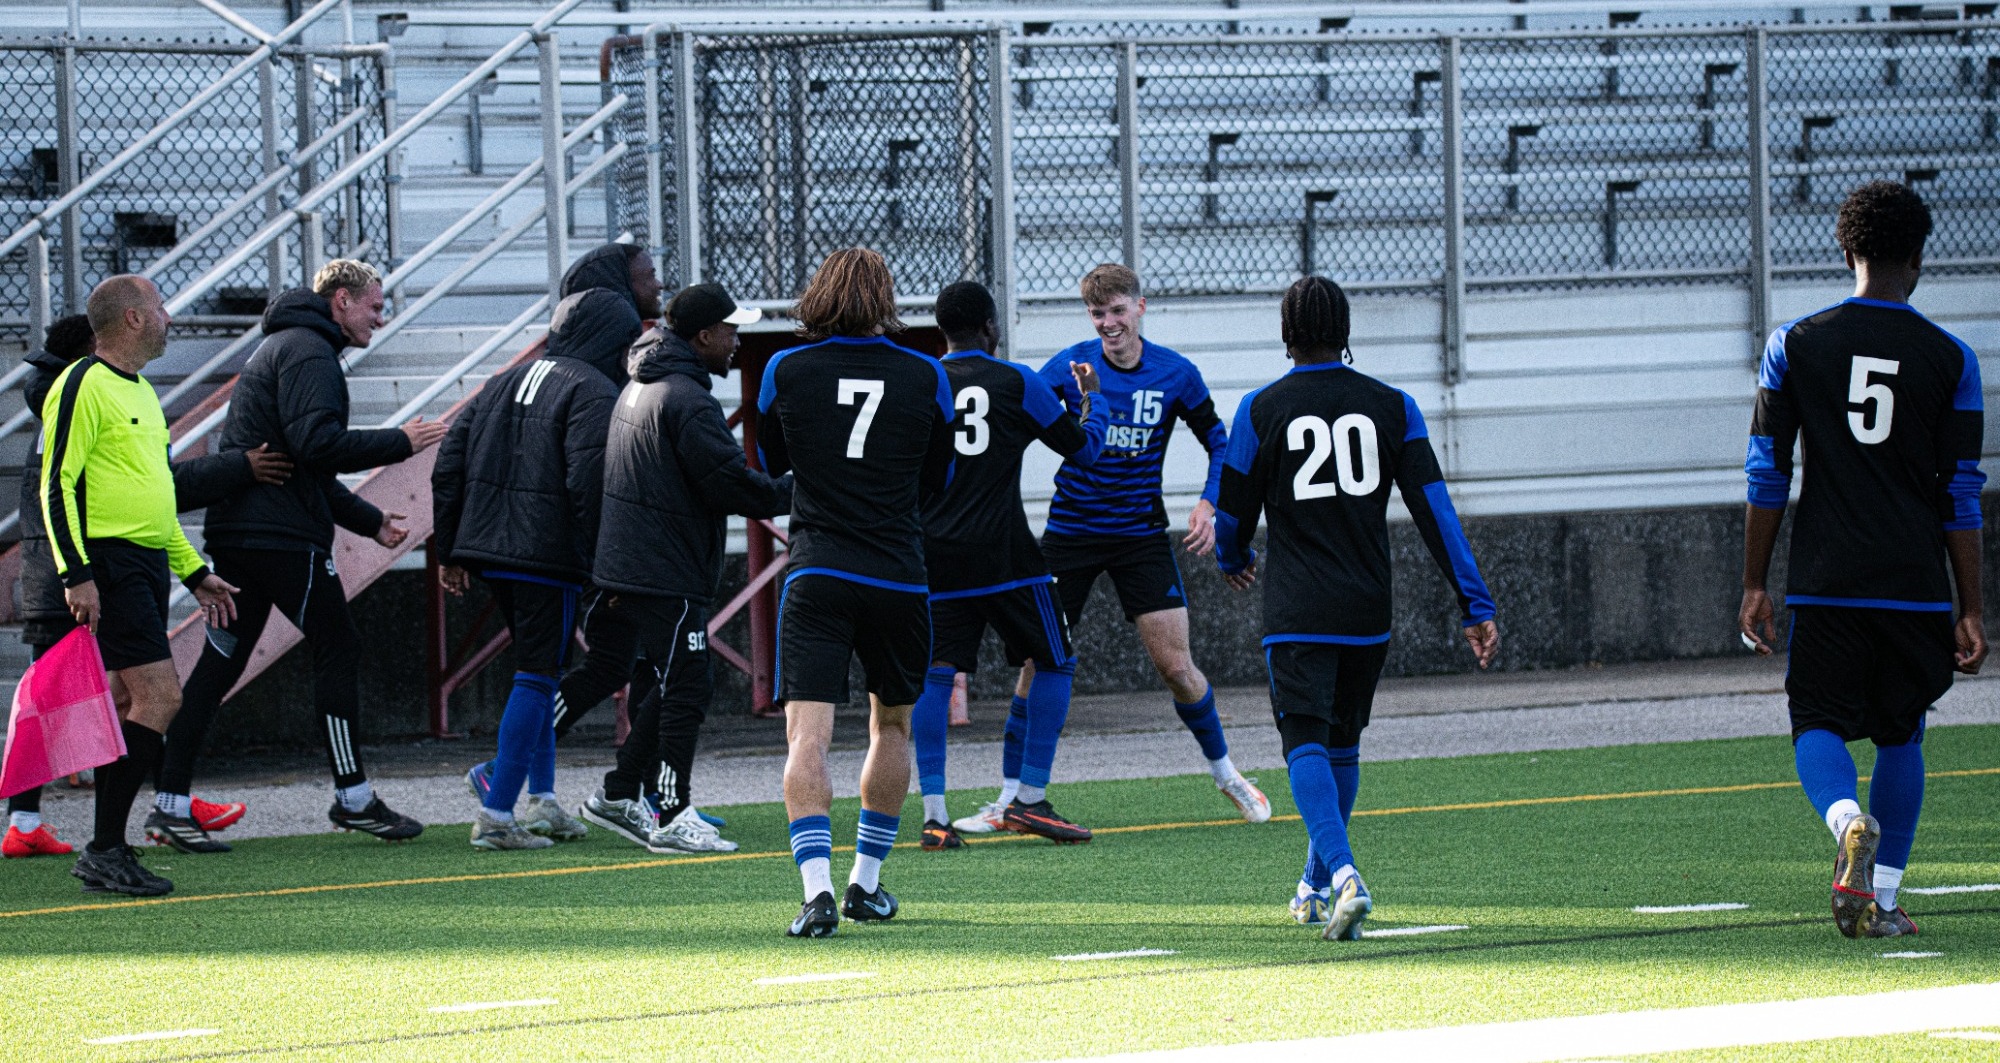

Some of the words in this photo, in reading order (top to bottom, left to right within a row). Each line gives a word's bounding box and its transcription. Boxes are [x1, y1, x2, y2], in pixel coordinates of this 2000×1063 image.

[837, 378, 884, 458] 7
[954, 386, 990, 455] 3
[1105, 424, 1154, 448] DSEY
[1132, 389, 1164, 425] 15
[1847, 355, 1900, 444] 5
[1287, 413, 1380, 500] 20
